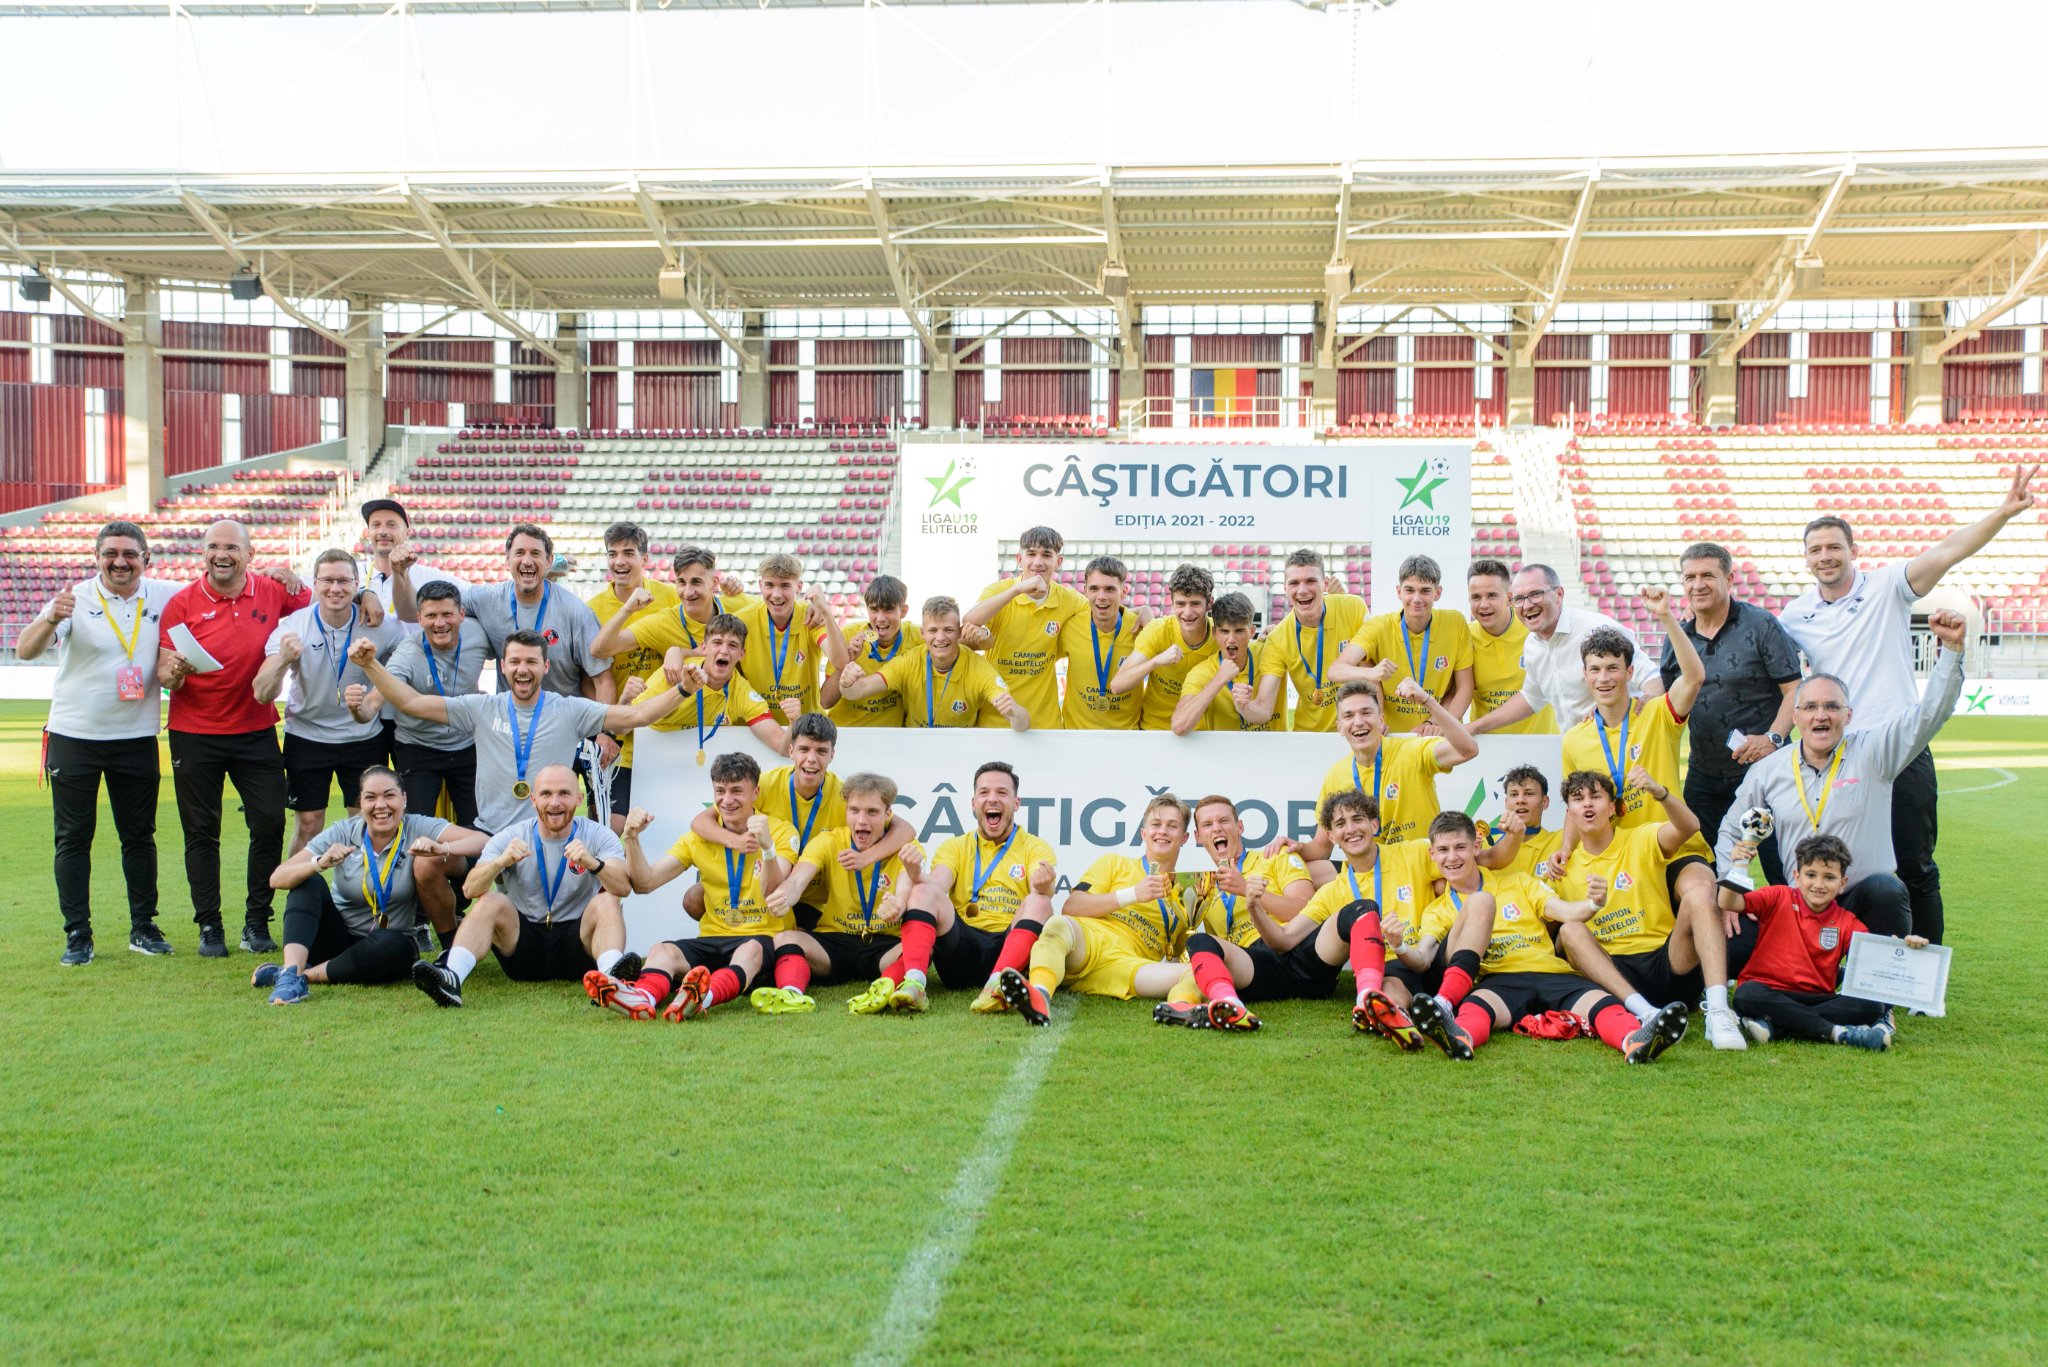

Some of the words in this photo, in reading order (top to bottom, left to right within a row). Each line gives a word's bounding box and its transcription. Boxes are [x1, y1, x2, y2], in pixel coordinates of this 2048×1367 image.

[1171, 515, 1204, 526] 2021
[1219, 515, 1255, 526] 2022
[922, 525, 977, 534] ELITELOR
[1393, 526, 1450, 536] ELITELOR
[1385, 694, 1400, 703] LIGA
[1594, 907, 1631, 926] CAMPION
[1129, 910, 1160, 937] CAMPION
[1600, 916, 1639, 935] ELITELOR
